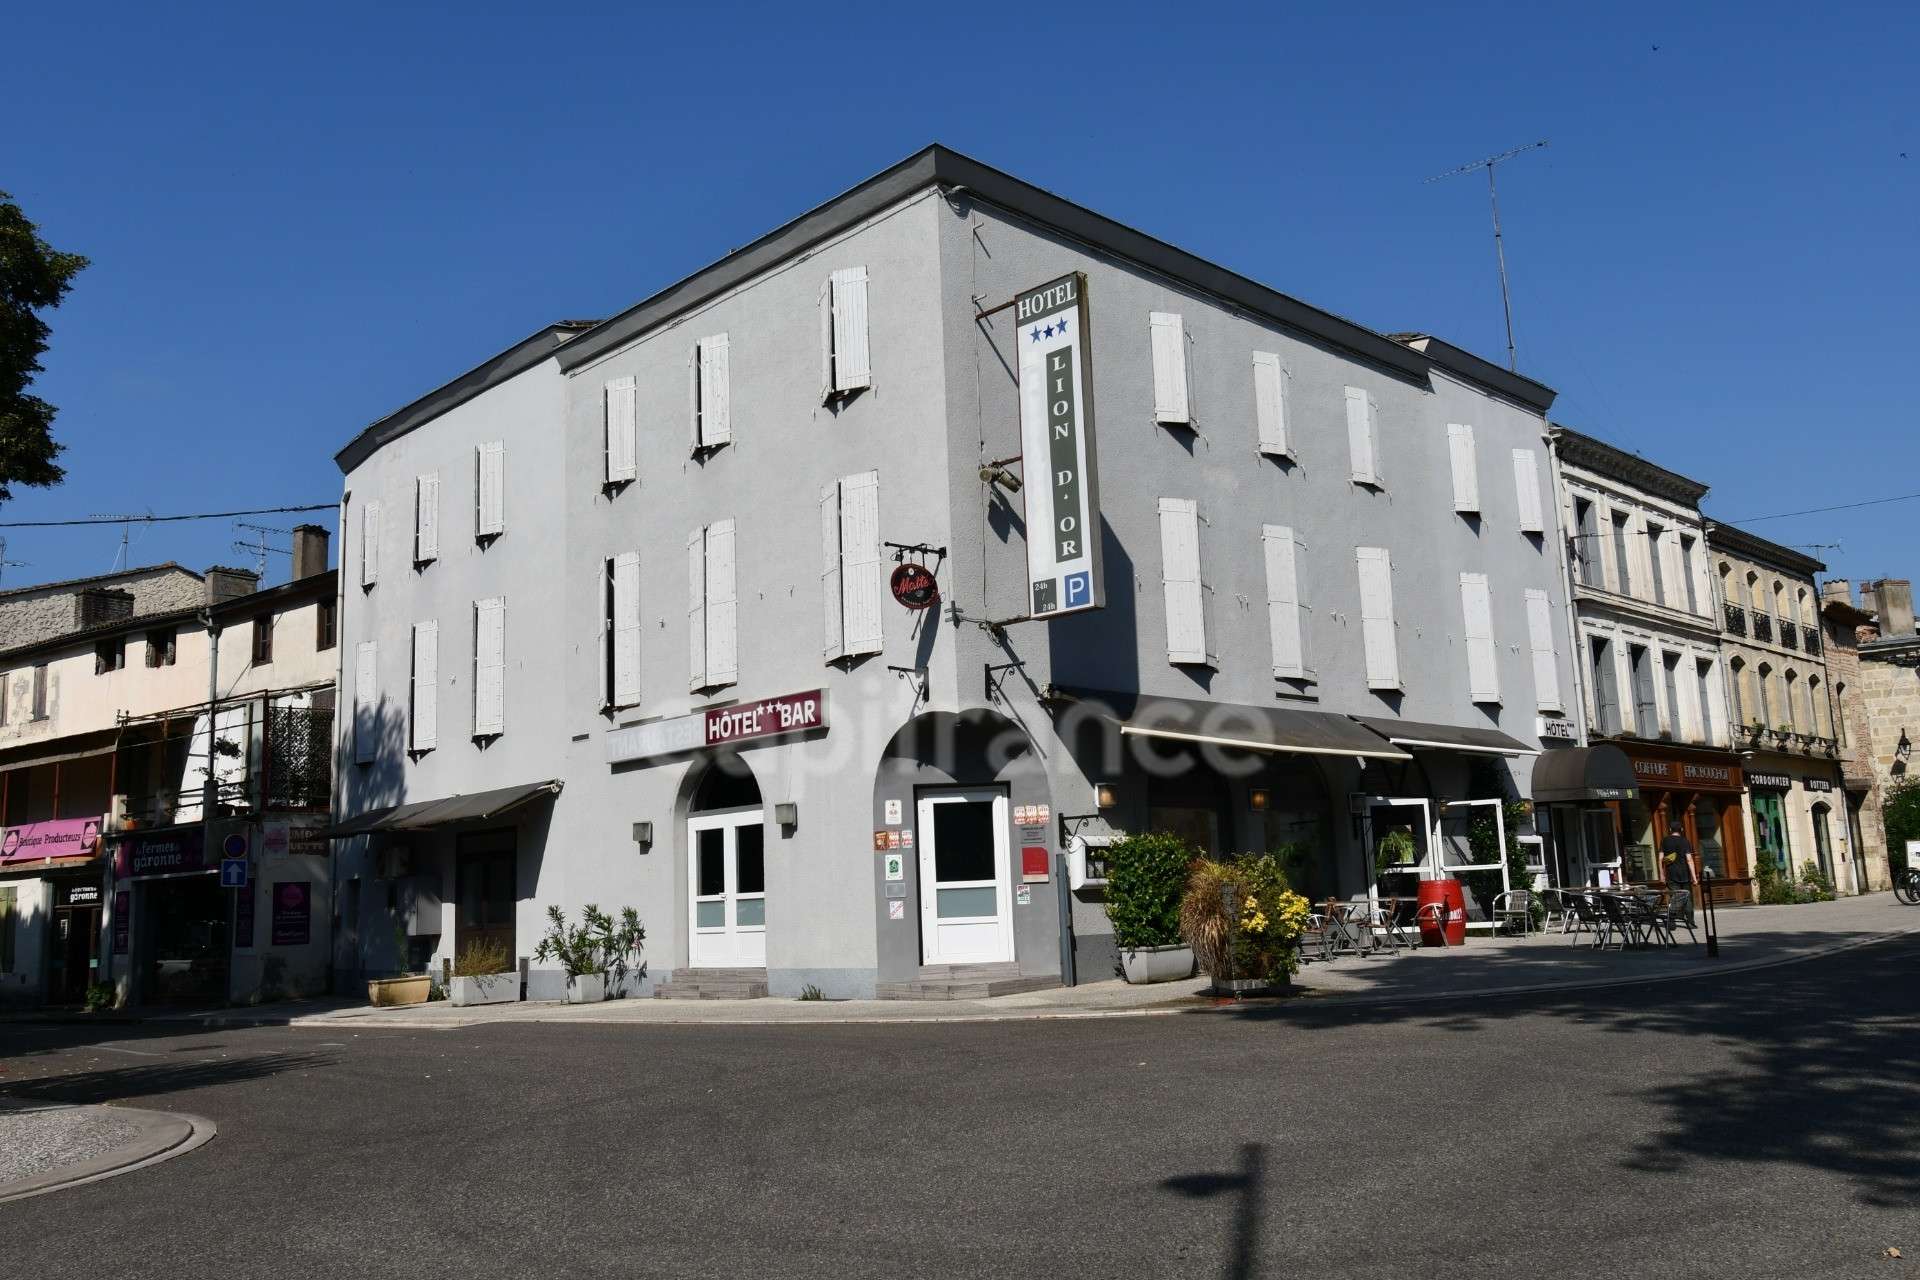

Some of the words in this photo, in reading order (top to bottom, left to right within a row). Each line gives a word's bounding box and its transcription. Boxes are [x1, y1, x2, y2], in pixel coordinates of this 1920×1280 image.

[1017, 281, 1077, 321] HOTEL
[1052, 356, 1070, 441] LION
[1034, 581, 1048, 592] 24h
[1069, 577, 1085, 604] P
[708, 710, 762, 741] HÔTEL
[780, 700, 815, 728] BAR
[1545, 720, 1570, 737] HÔTEL
